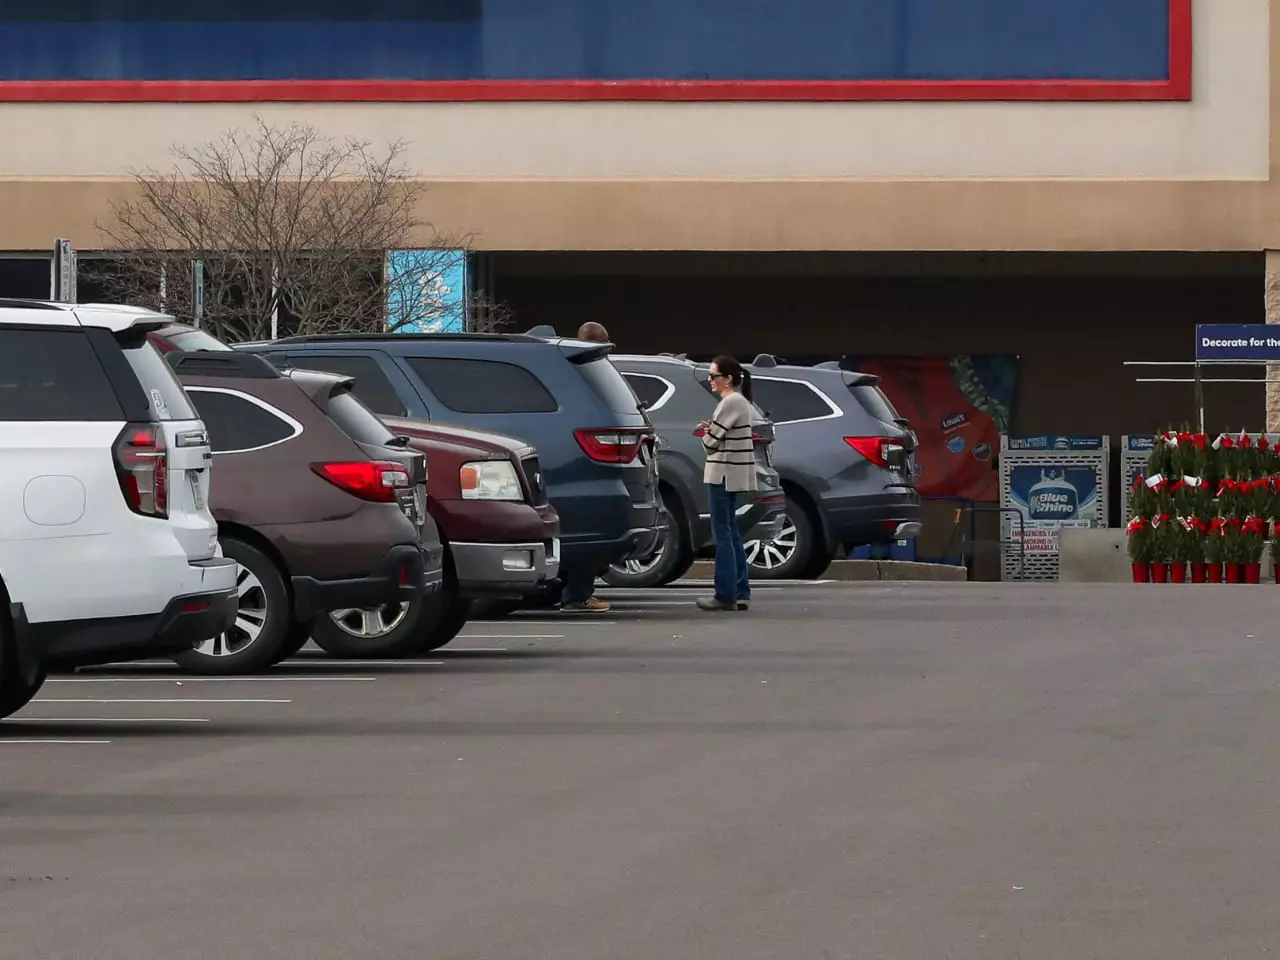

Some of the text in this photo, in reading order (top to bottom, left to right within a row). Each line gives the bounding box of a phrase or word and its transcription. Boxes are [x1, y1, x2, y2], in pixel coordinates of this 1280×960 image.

[1202, 337, 1248, 347] Decorate
[1249, 337, 1264, 347] for
[1040, 493, 1068, 502] Blue
